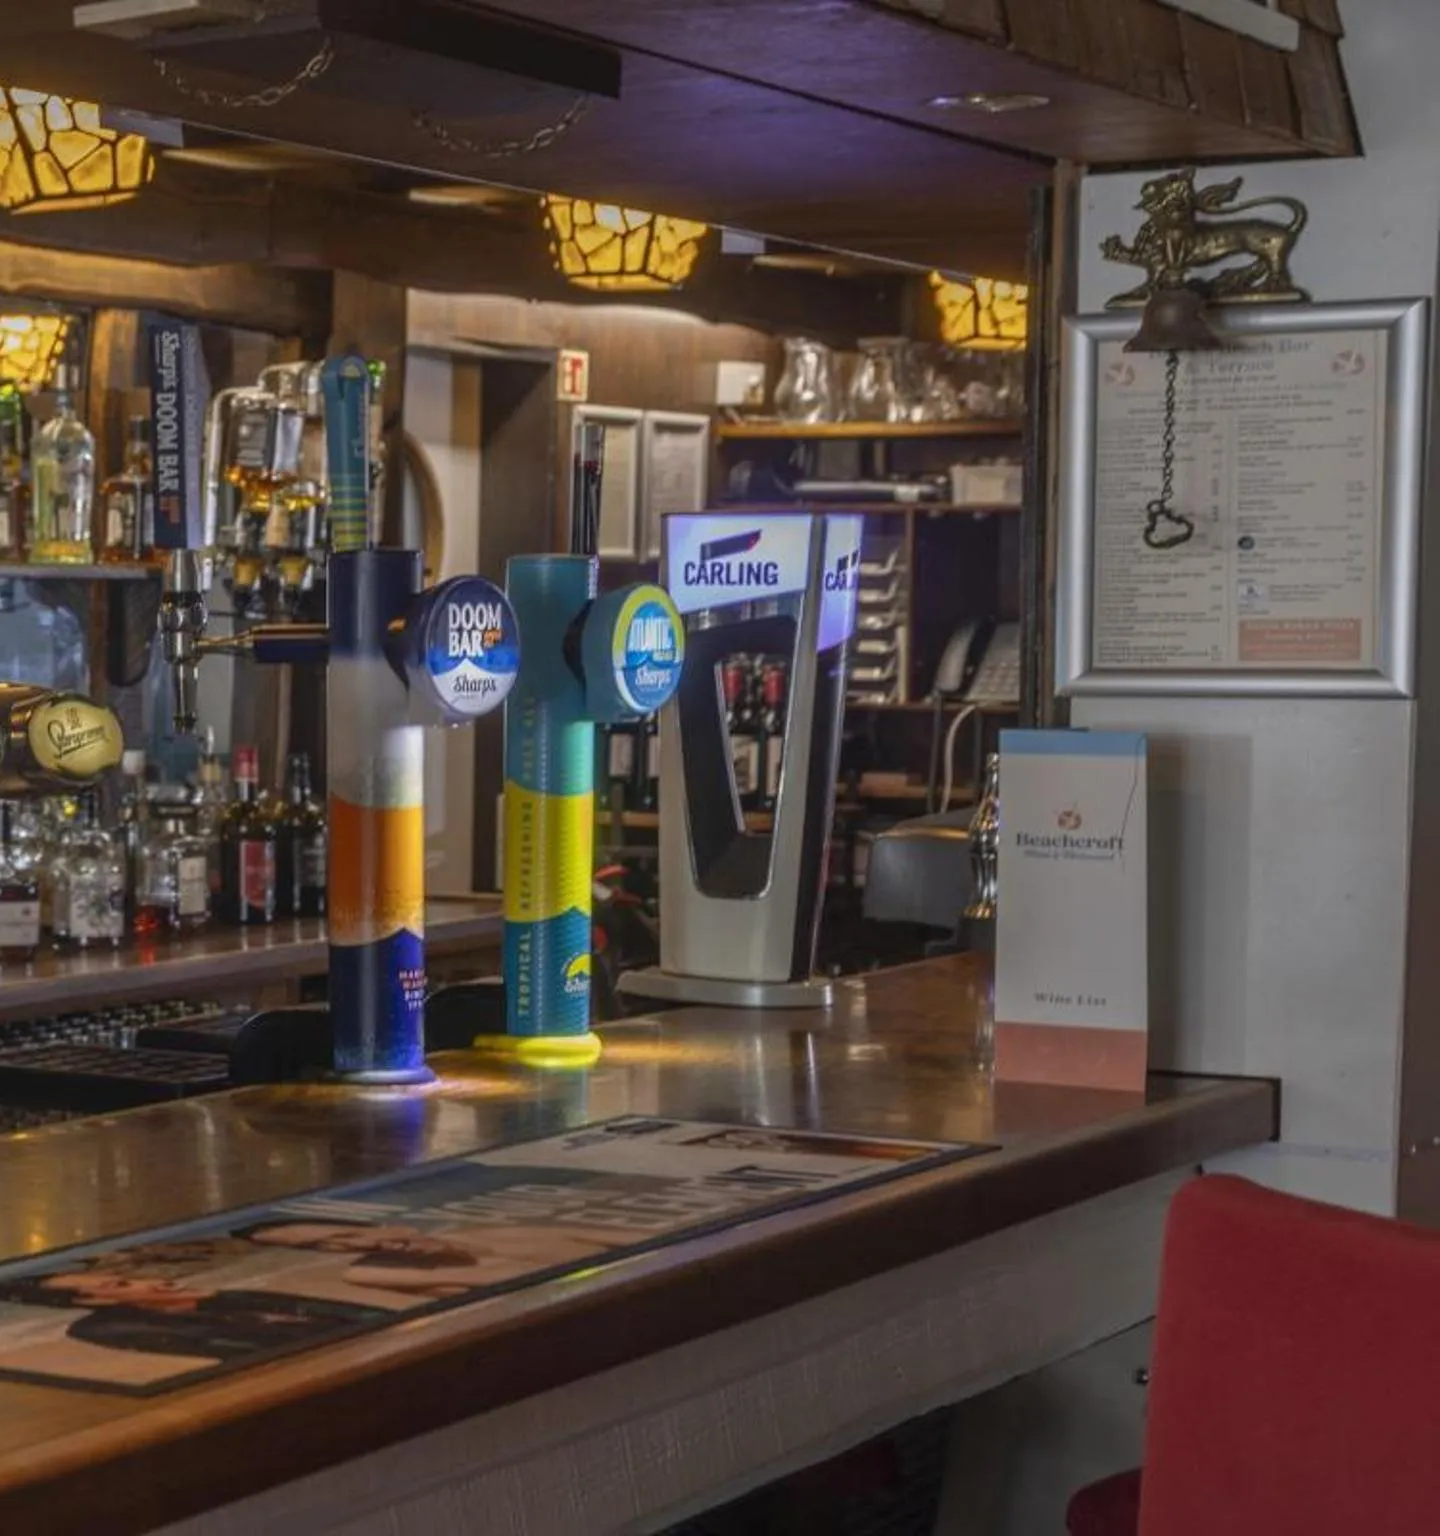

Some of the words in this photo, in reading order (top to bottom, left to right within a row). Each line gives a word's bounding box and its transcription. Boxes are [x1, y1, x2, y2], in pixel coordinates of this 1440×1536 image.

[156, 392, 179, 449] DOOM
[158, 453, 179, 491] BAR
[683, 560, 780, 586] CARLING
[448, 602, 502, 630] DOOM
[448, 630, 484, 657] BAR
[1015, 831, 1123, 850] Beachcroft
[517, 931, 532, 1016] TROPICAL
[554, 1164, 843, 1230] ELEMENT
